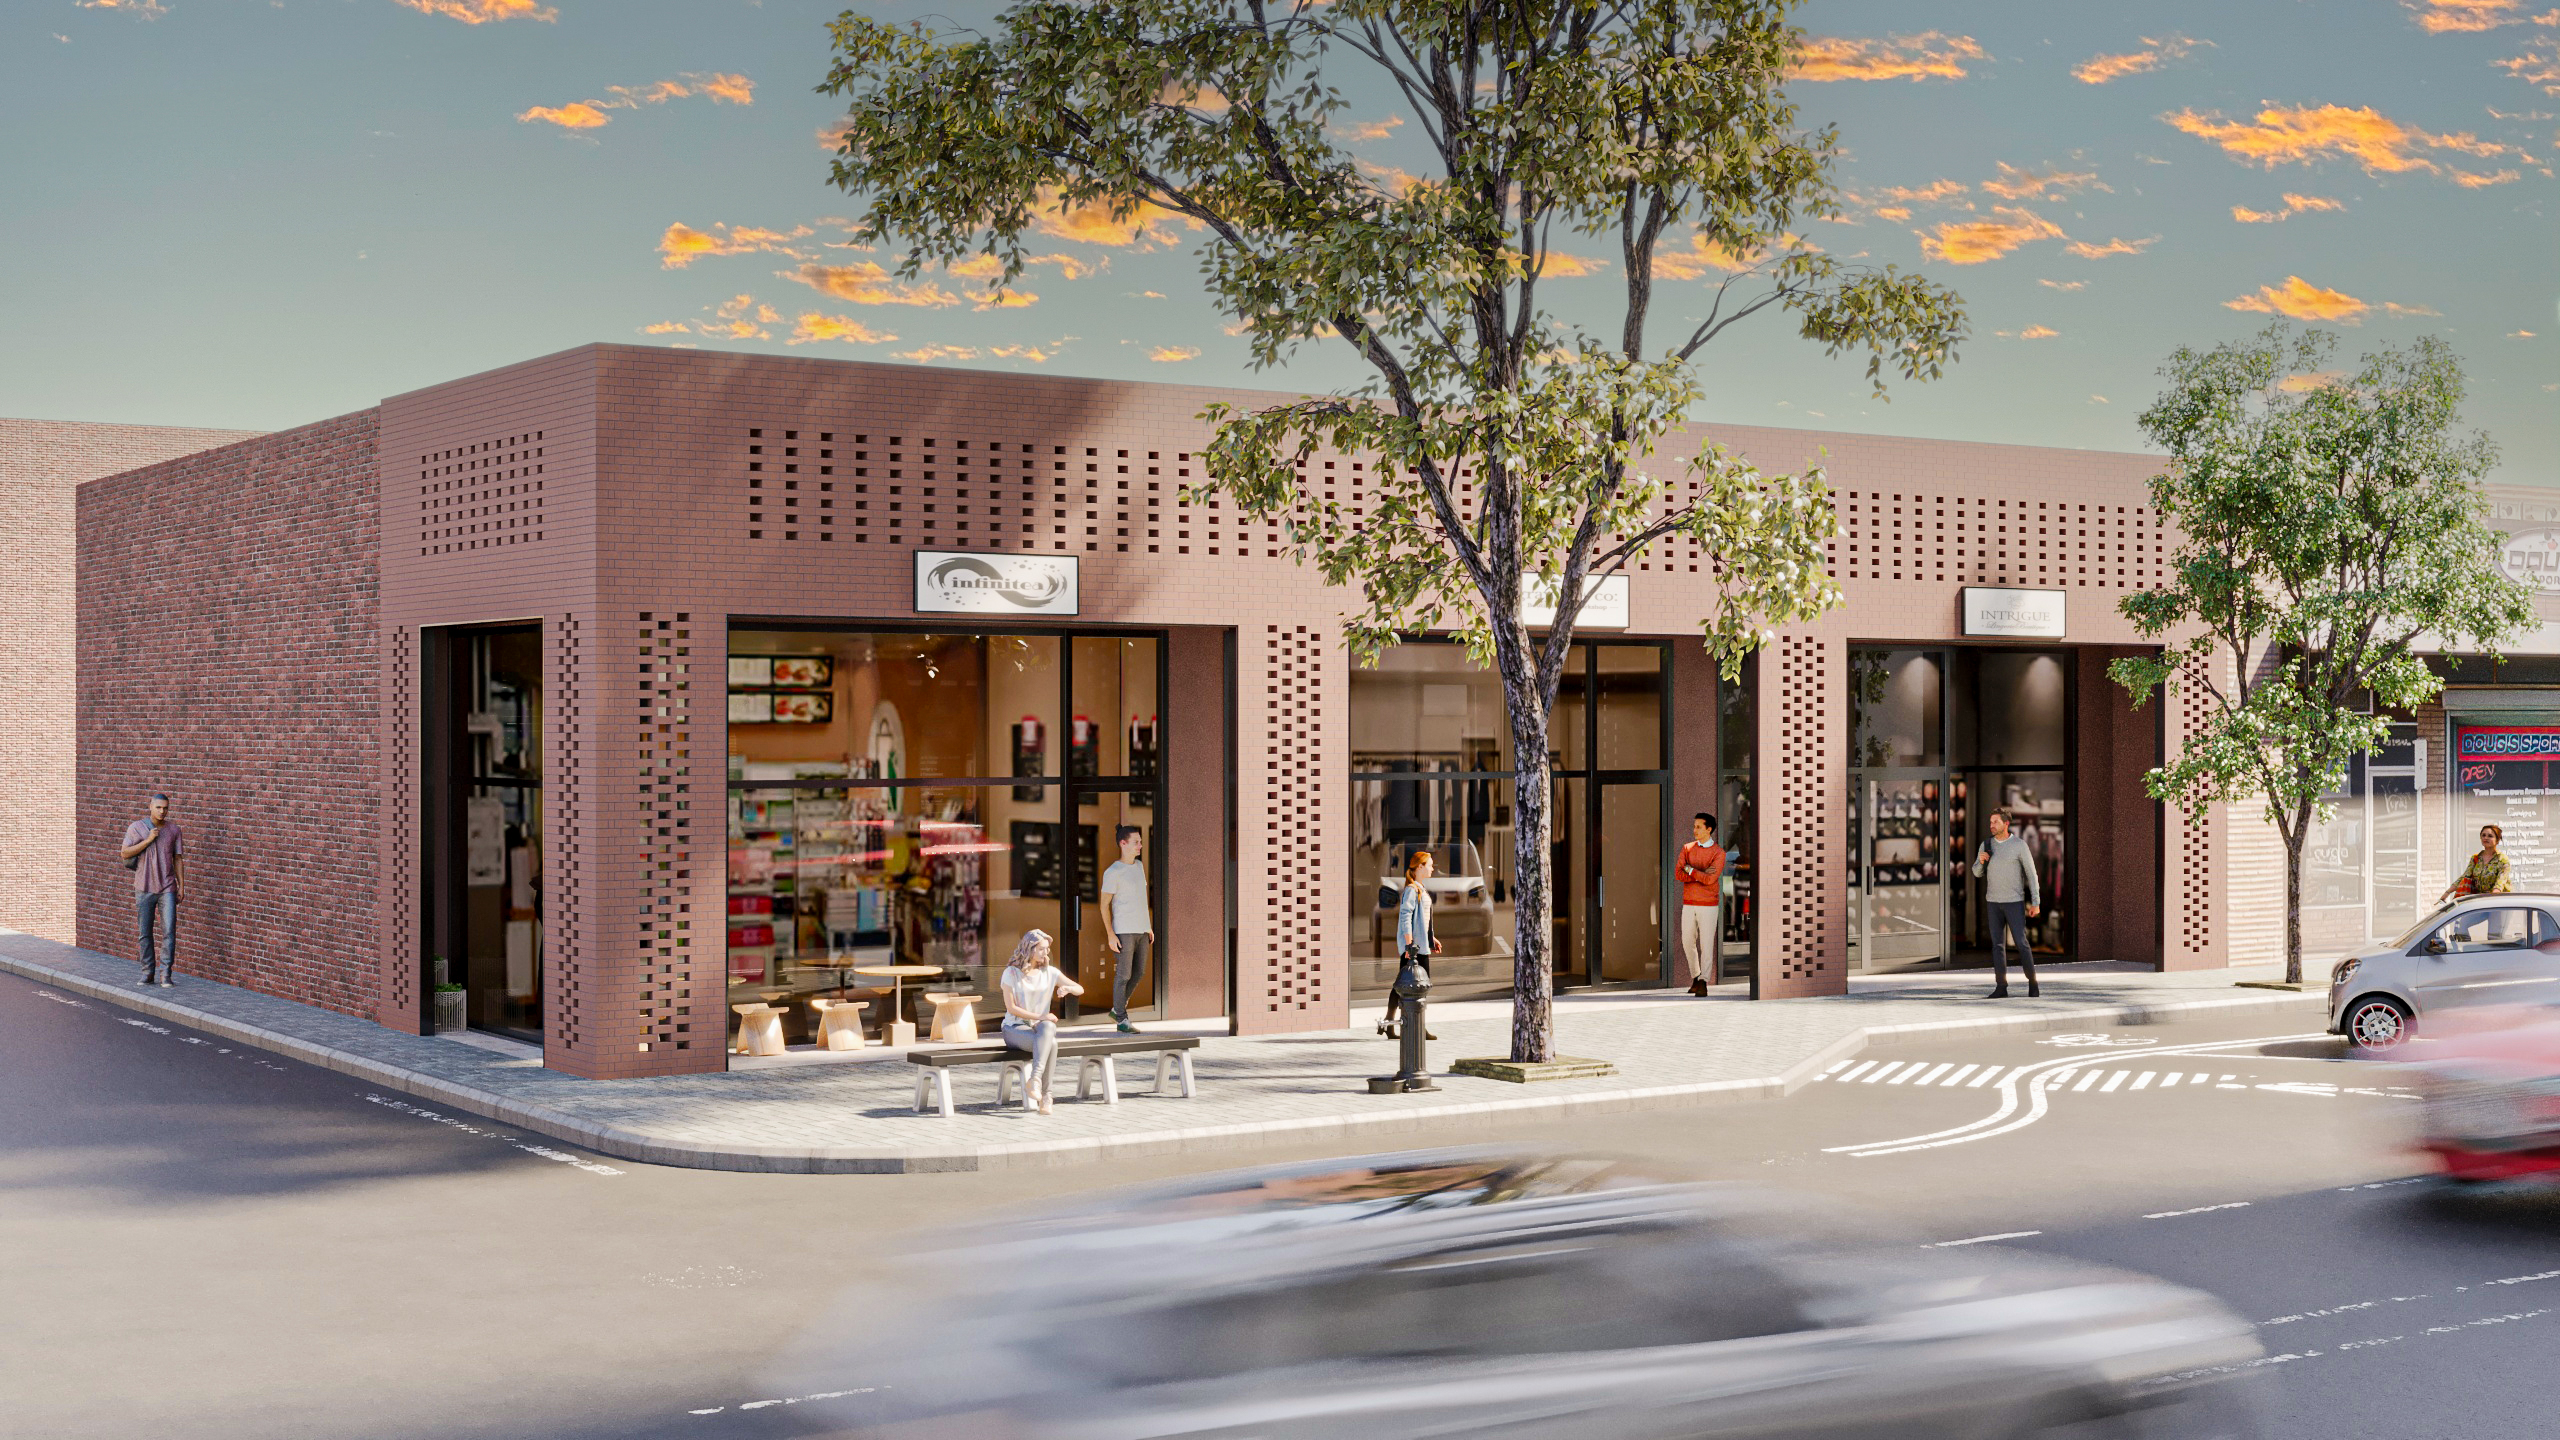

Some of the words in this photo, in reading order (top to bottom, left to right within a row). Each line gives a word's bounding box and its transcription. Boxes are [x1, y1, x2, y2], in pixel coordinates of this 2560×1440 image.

[953, 576, 1044, 591] infinitea
[1981, 610, 2050, 622] INTRIGUE
[2461, 764, 2495, 782] OPEN
